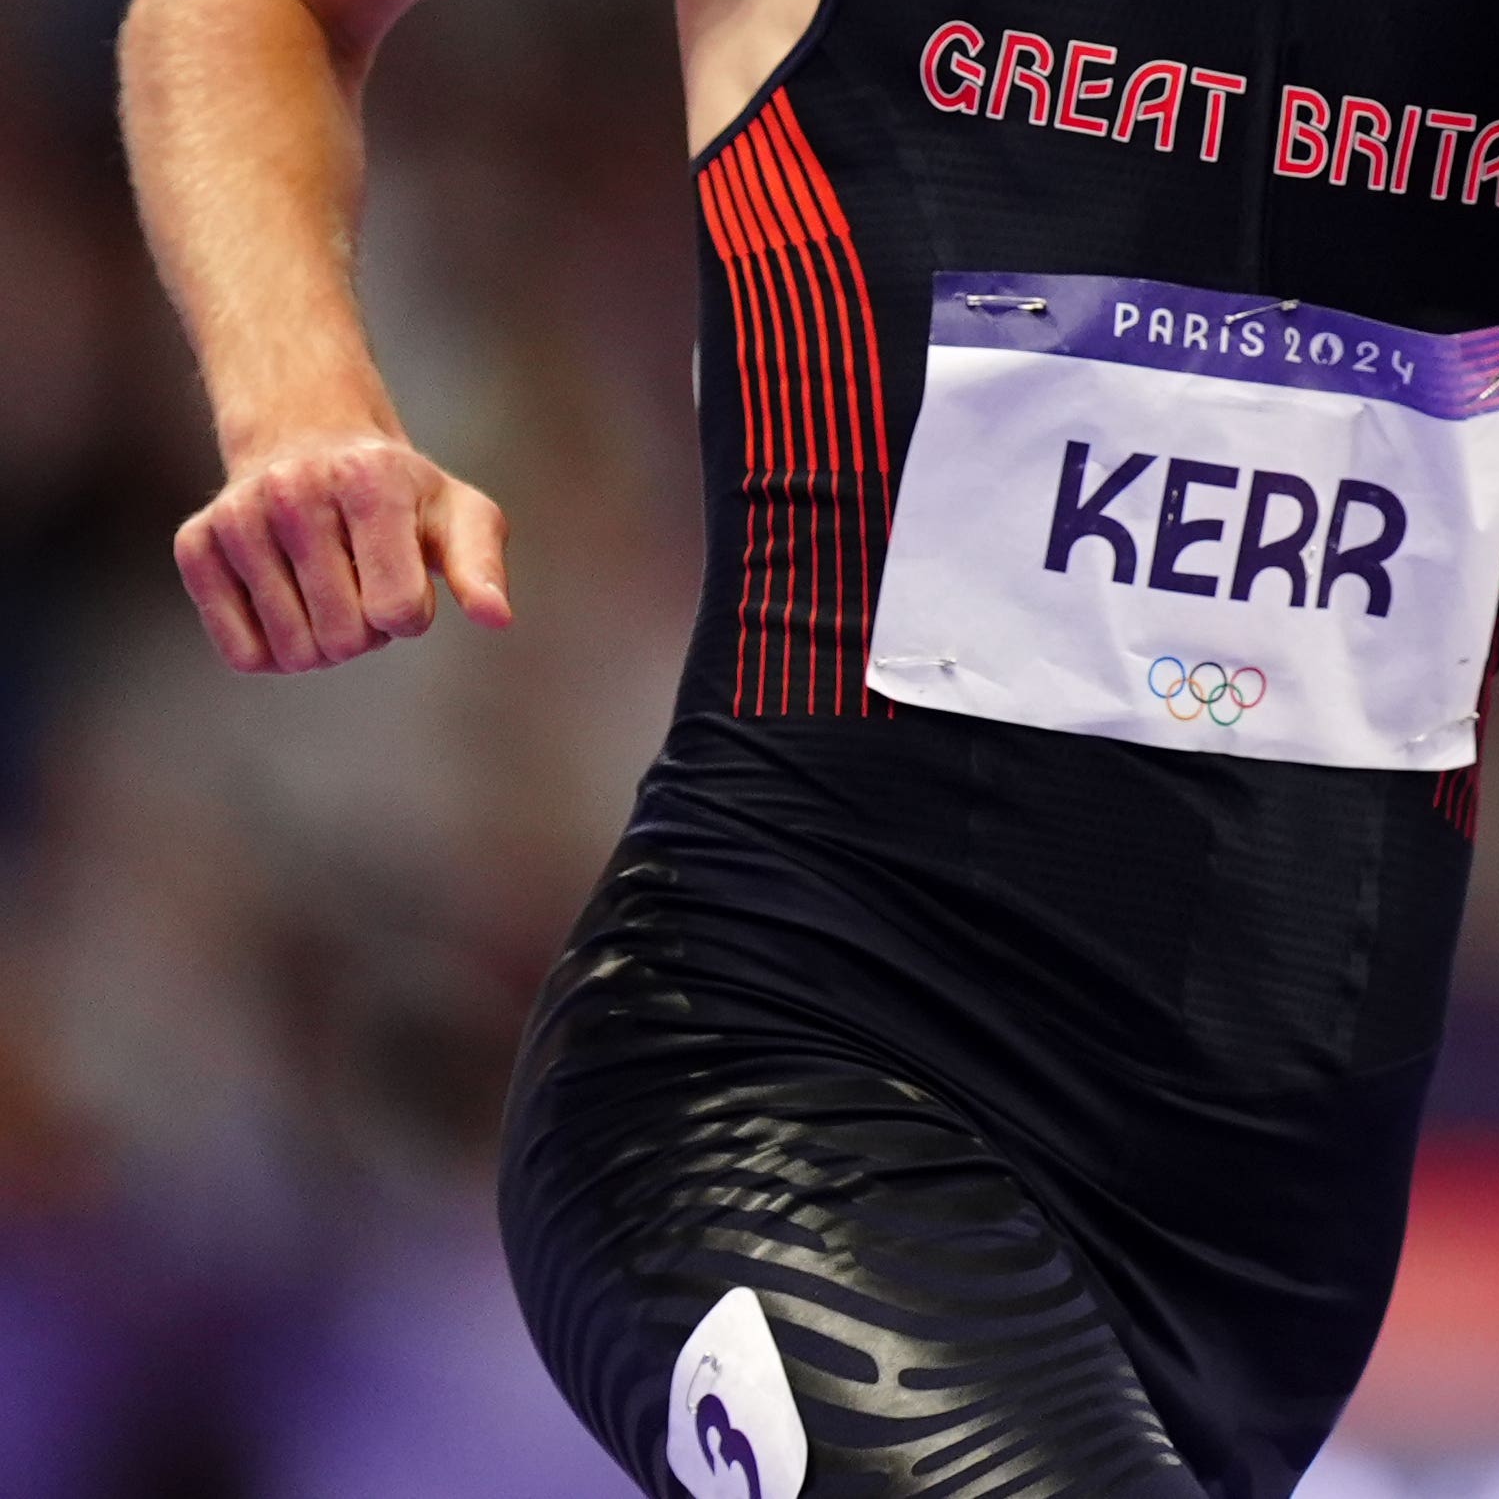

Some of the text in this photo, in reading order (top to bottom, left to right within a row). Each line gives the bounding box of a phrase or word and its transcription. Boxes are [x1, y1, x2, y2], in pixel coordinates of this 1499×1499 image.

[919, 20, 1246, 162] GREAT
[1284, 326, 1415, 385] 2024
[1043, 440, 1408, 619] KERR
[696, 1393, 762, 1499] 3
